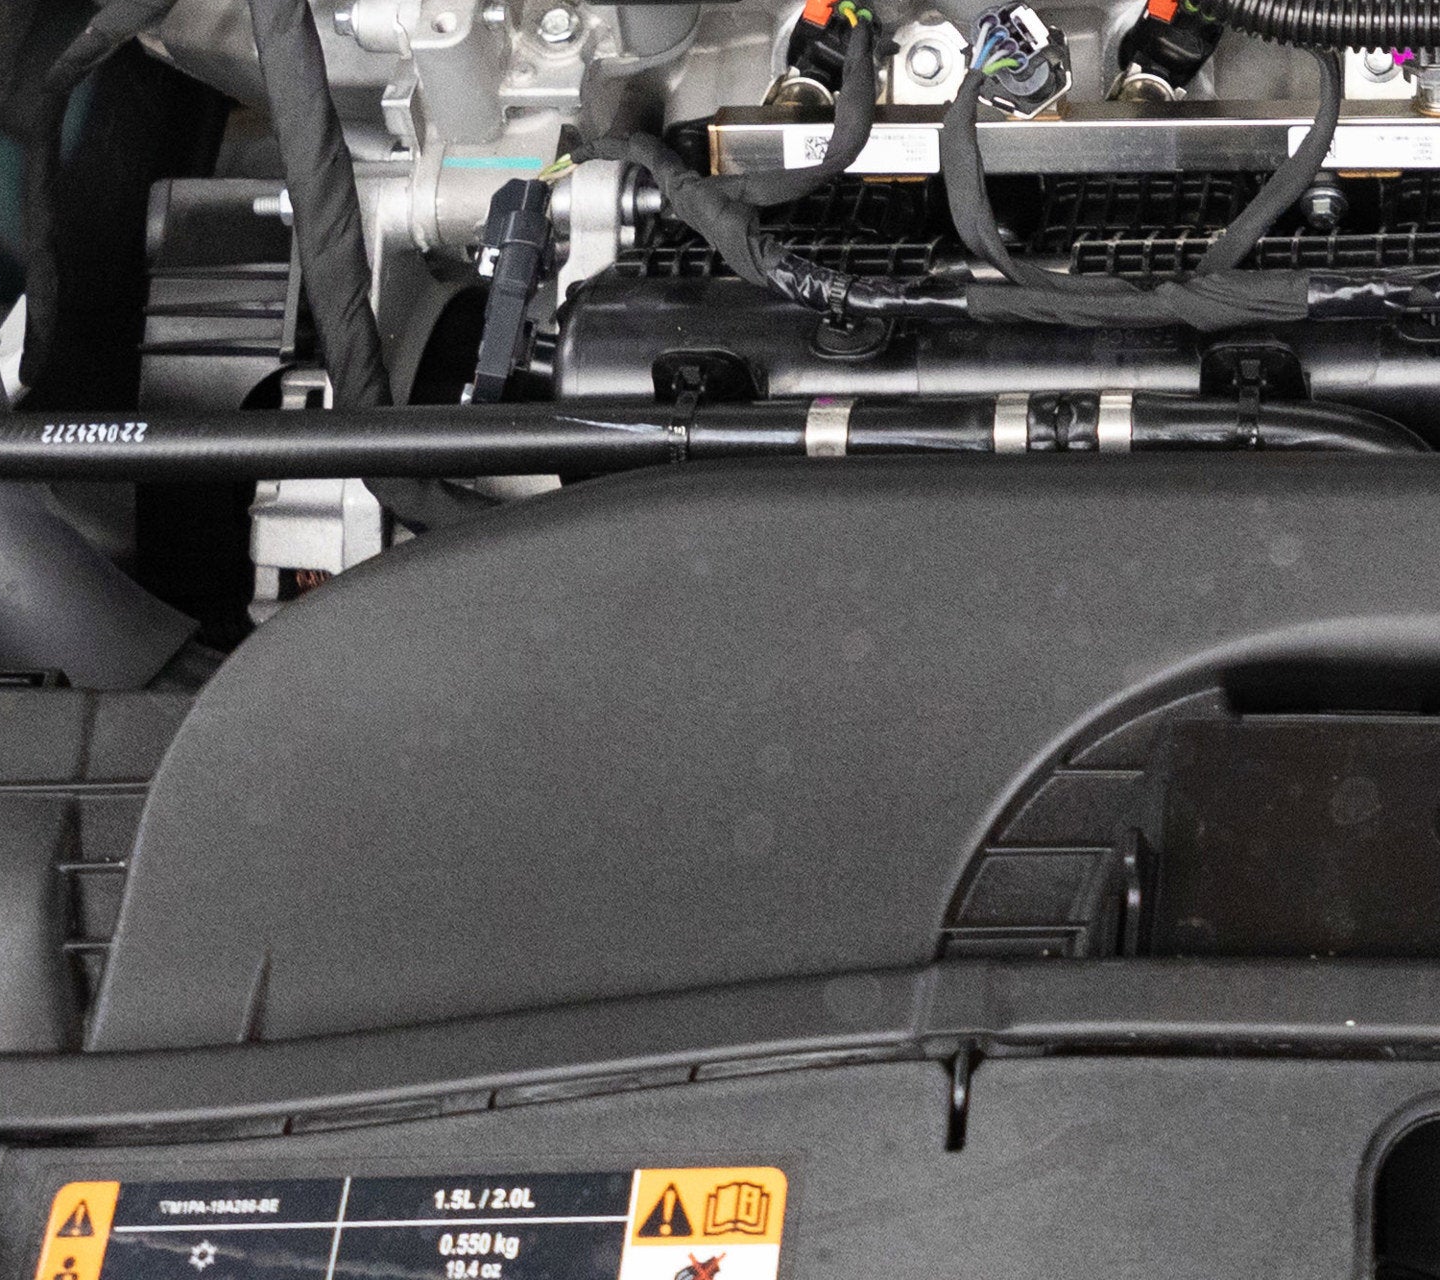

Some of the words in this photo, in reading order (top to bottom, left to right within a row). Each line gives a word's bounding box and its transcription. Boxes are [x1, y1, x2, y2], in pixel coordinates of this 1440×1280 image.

[434, 1189, 475, 1209] 1.5L
[477, 1189, 489, 1209] /
[492, 1188, 536, 1209] 2.0L
[439, 1233, 491, 1256] 0.550
[494, 1232, 520, 1259] kg
[446, 1260, 479, 1279] 19.4
[481, 1263, 502, 1278] oz
